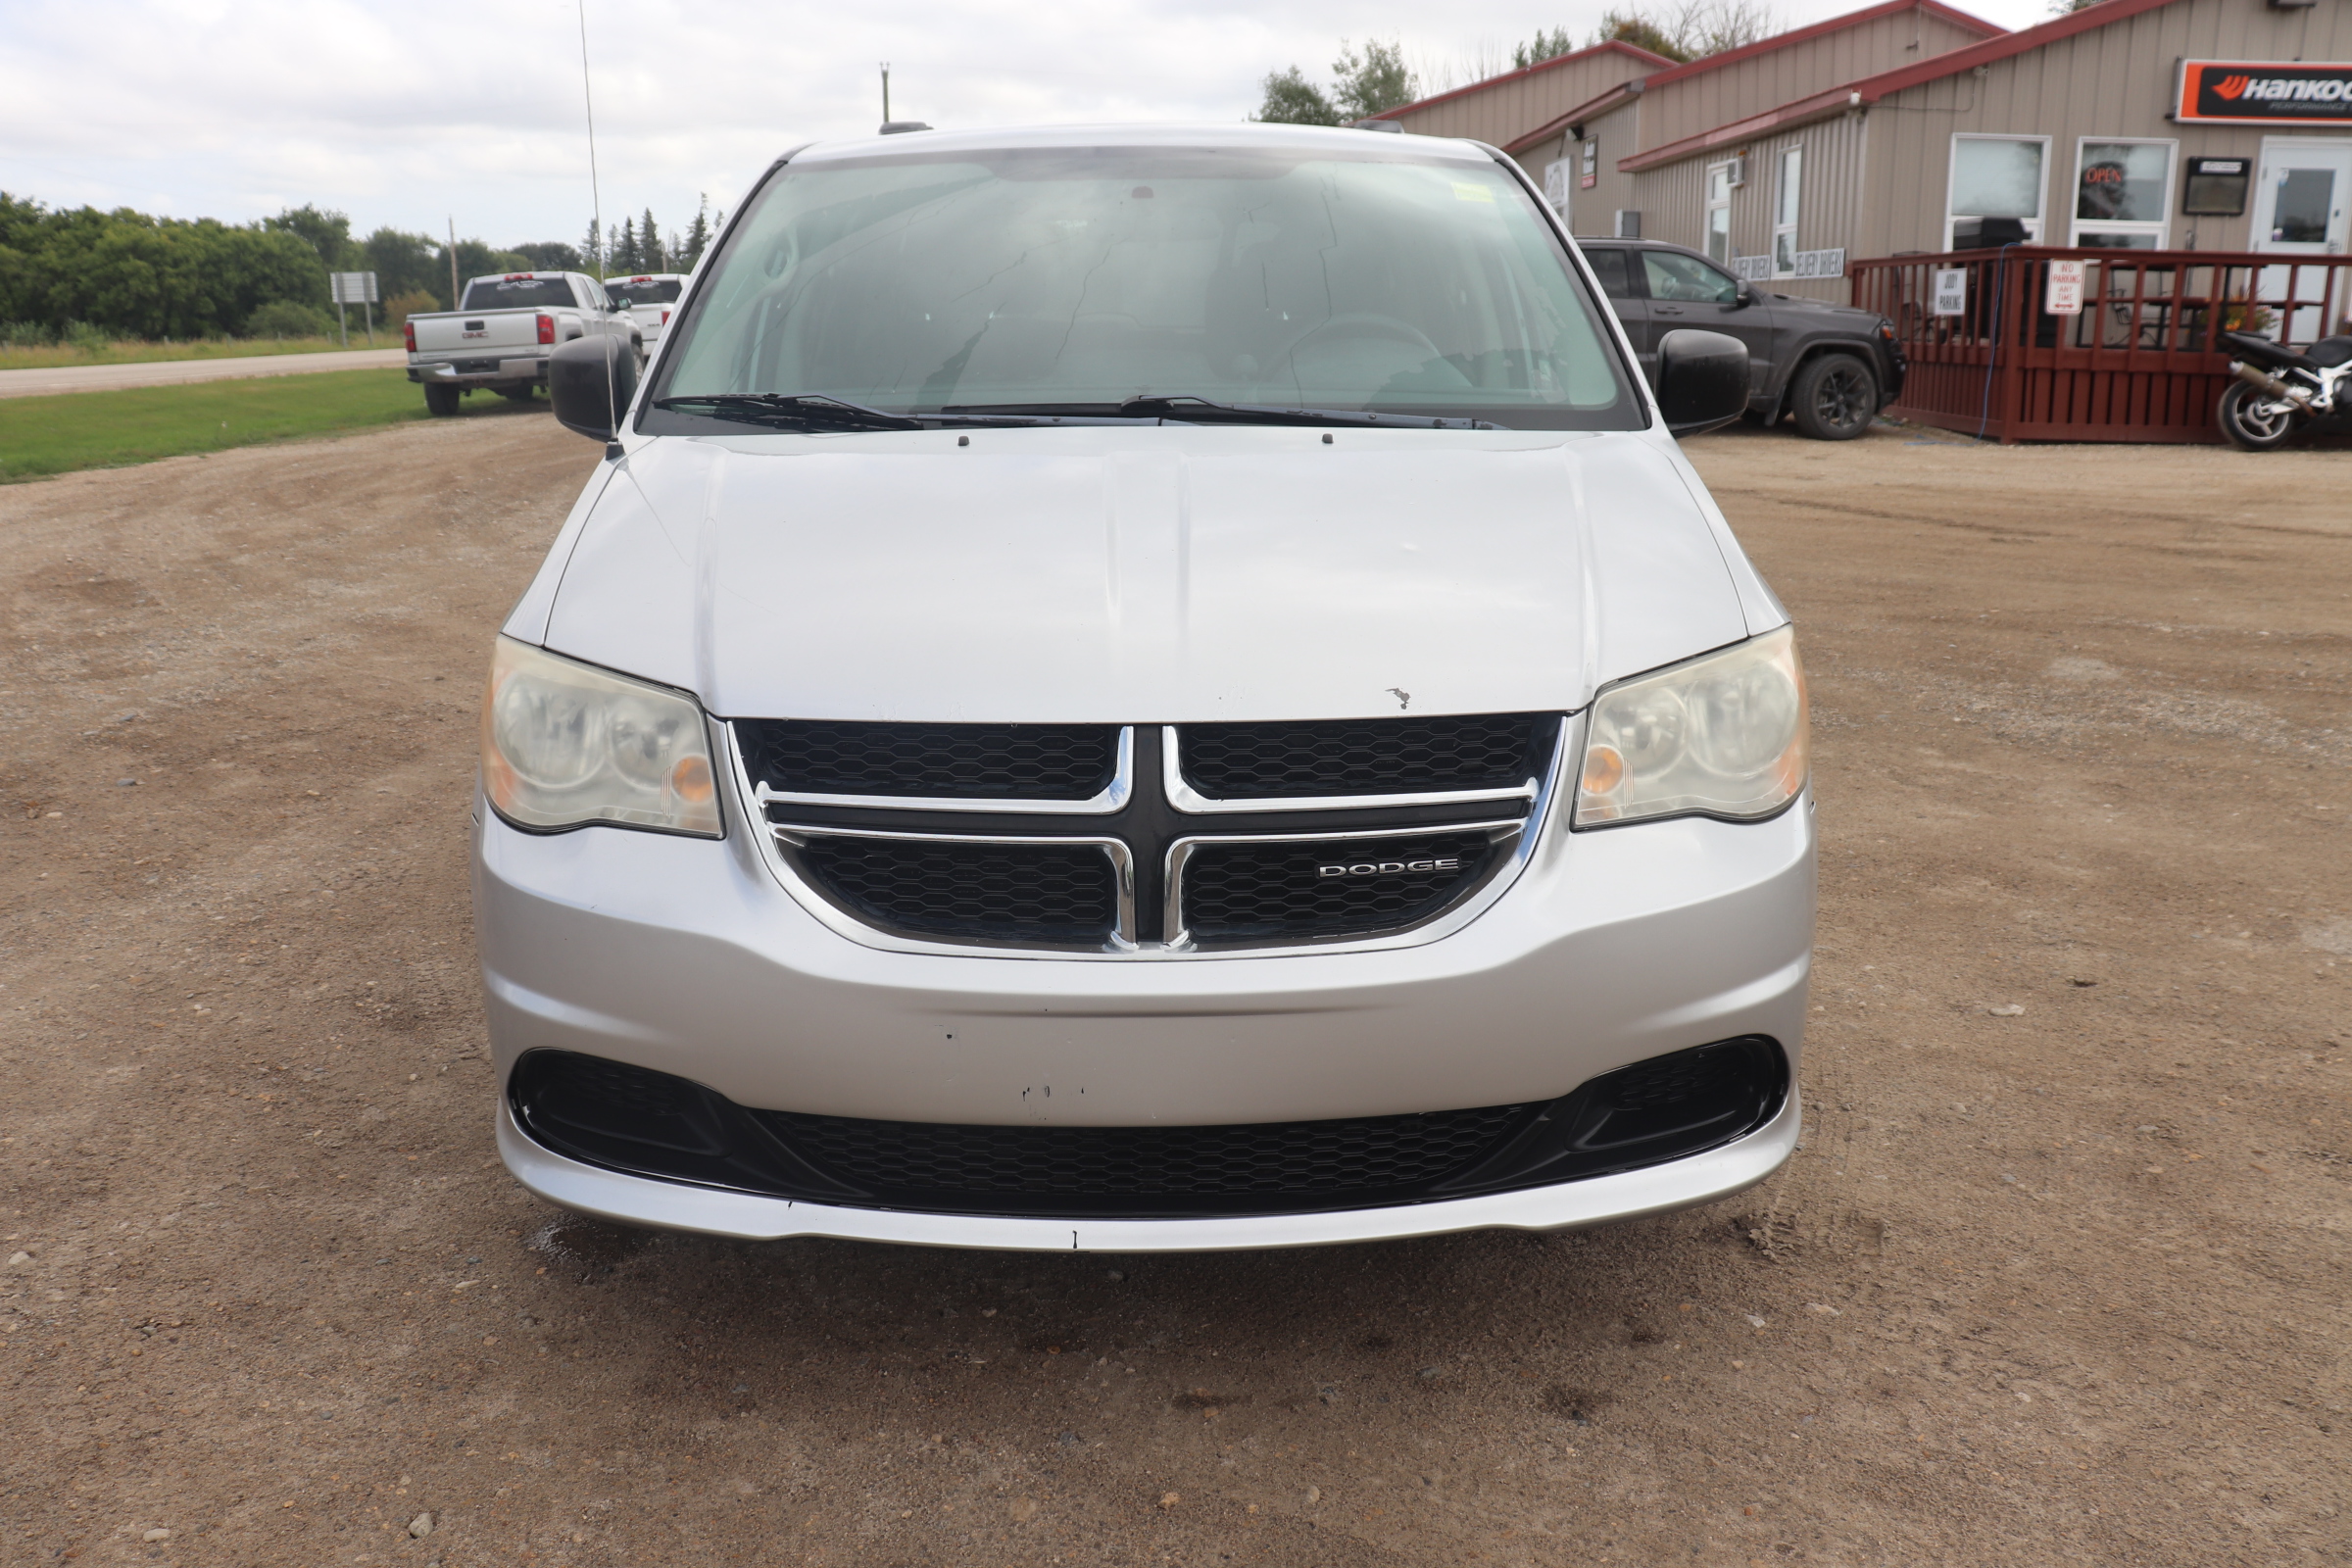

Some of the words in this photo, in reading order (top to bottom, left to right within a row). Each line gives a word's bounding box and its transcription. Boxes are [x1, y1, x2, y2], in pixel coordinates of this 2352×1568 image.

[2085, 167, 2123, 183] OPEN
[1795, 252, 1819, 276] DELIVERY
[1819, 250, 1842, 275] DRIVERS
[2061, 264, 2075, 272] NO
[2052, 274, 2082, 283] PARKING
[1938, 294, 1962, 311] PARKING
[1319, 858, 1459, 878] DODGE
